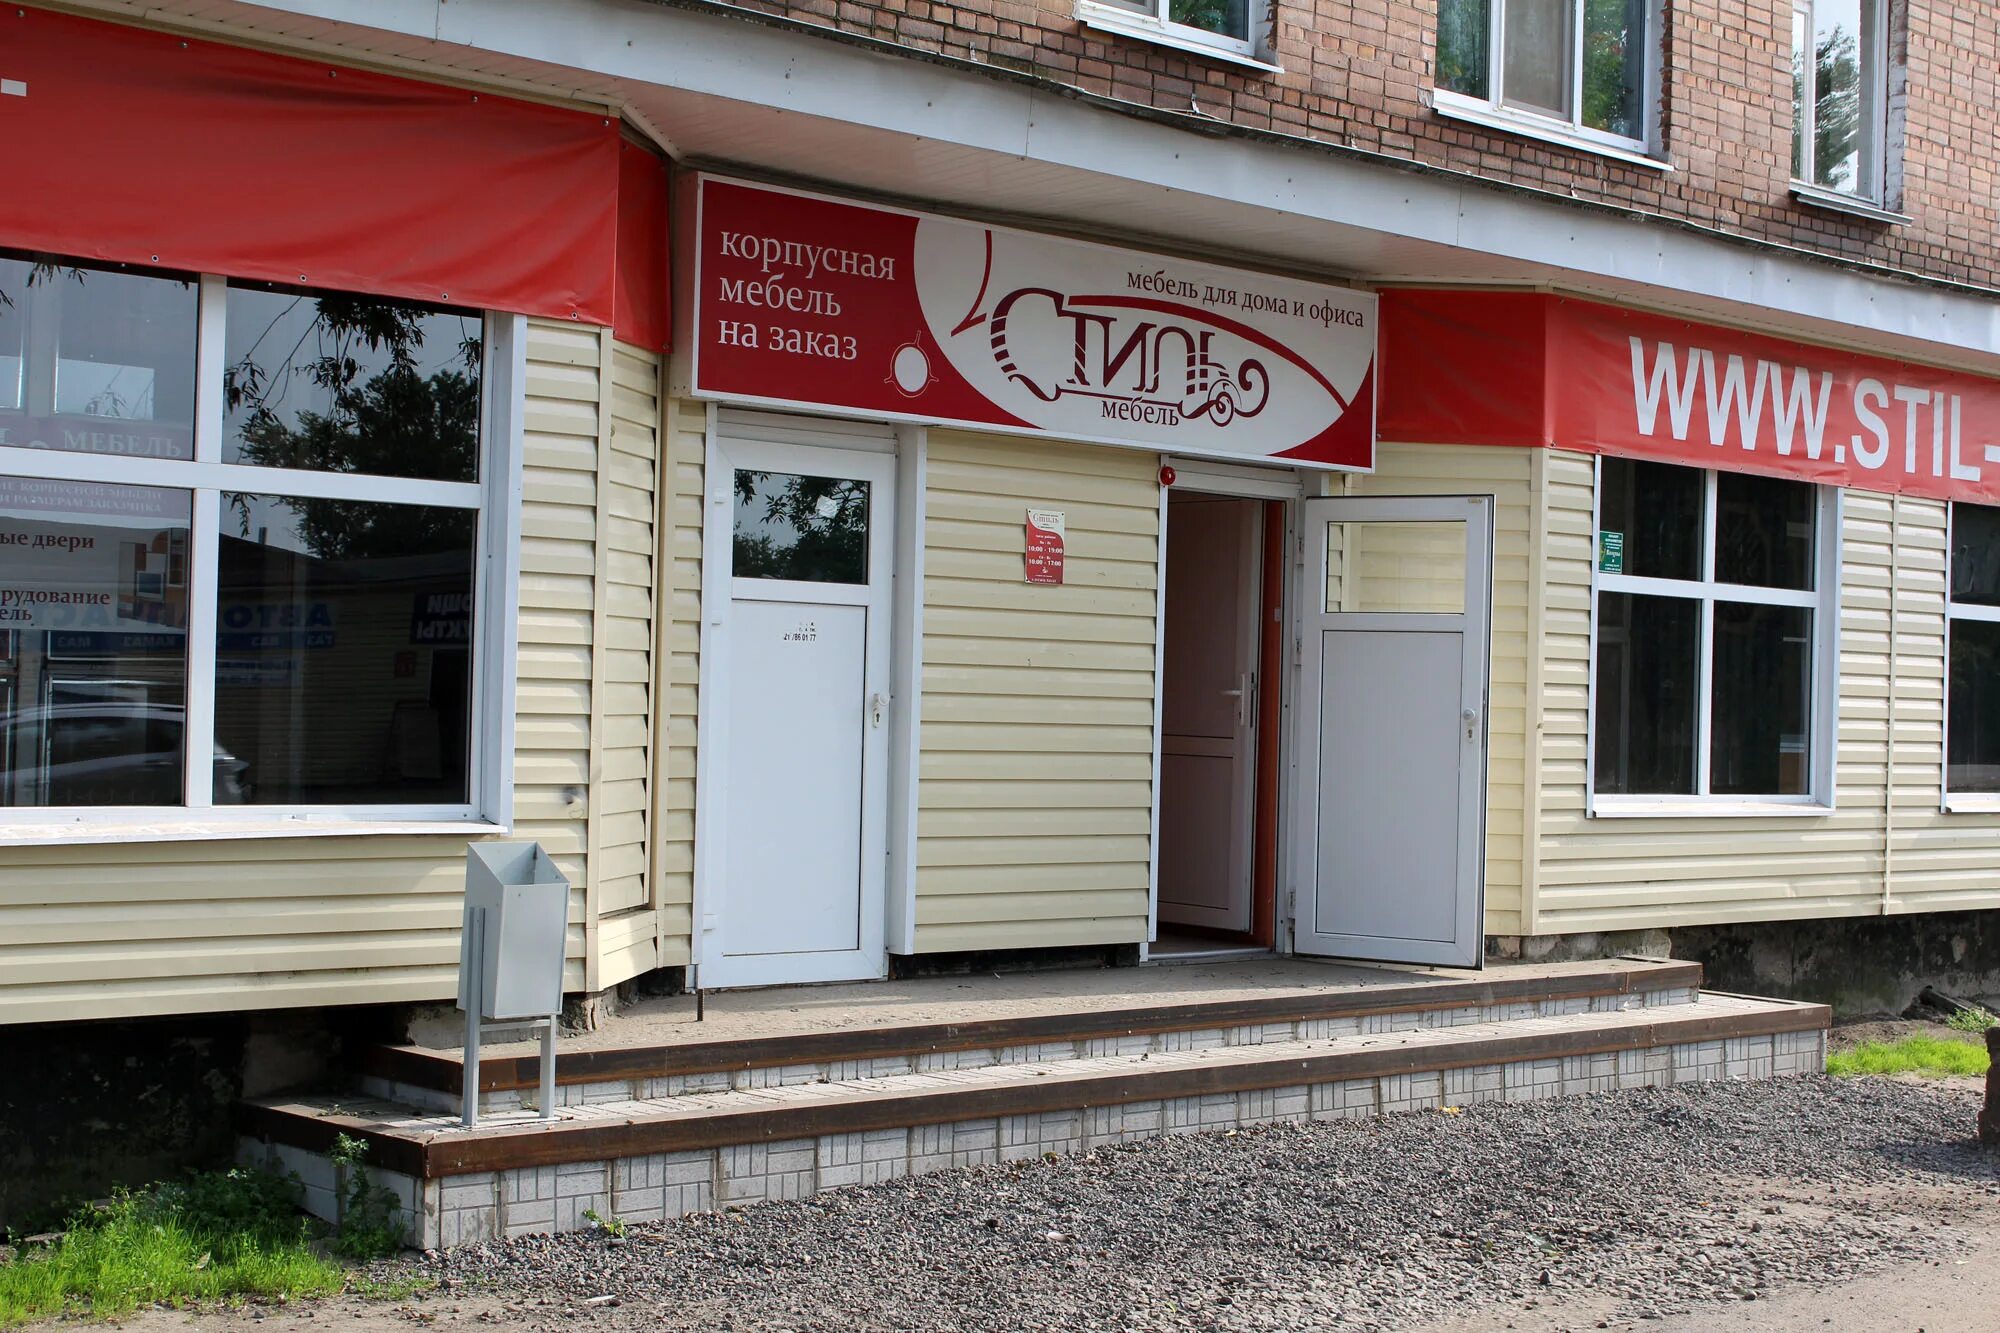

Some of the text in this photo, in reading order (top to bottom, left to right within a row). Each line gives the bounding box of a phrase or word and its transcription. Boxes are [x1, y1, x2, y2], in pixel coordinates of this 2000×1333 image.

[720, 232, 895, 281] корпусная
[719, 272, 841, 316] мебель
[1127, 270, 1364, 329] мебель для дома и офиса
[718, 320, 857, 360] на заказ
[1101, 397, 1179, 426] мебель
[64, 430, 182, 457] МЕБЕЛЬ
[32, 533, 95, 552] двери
